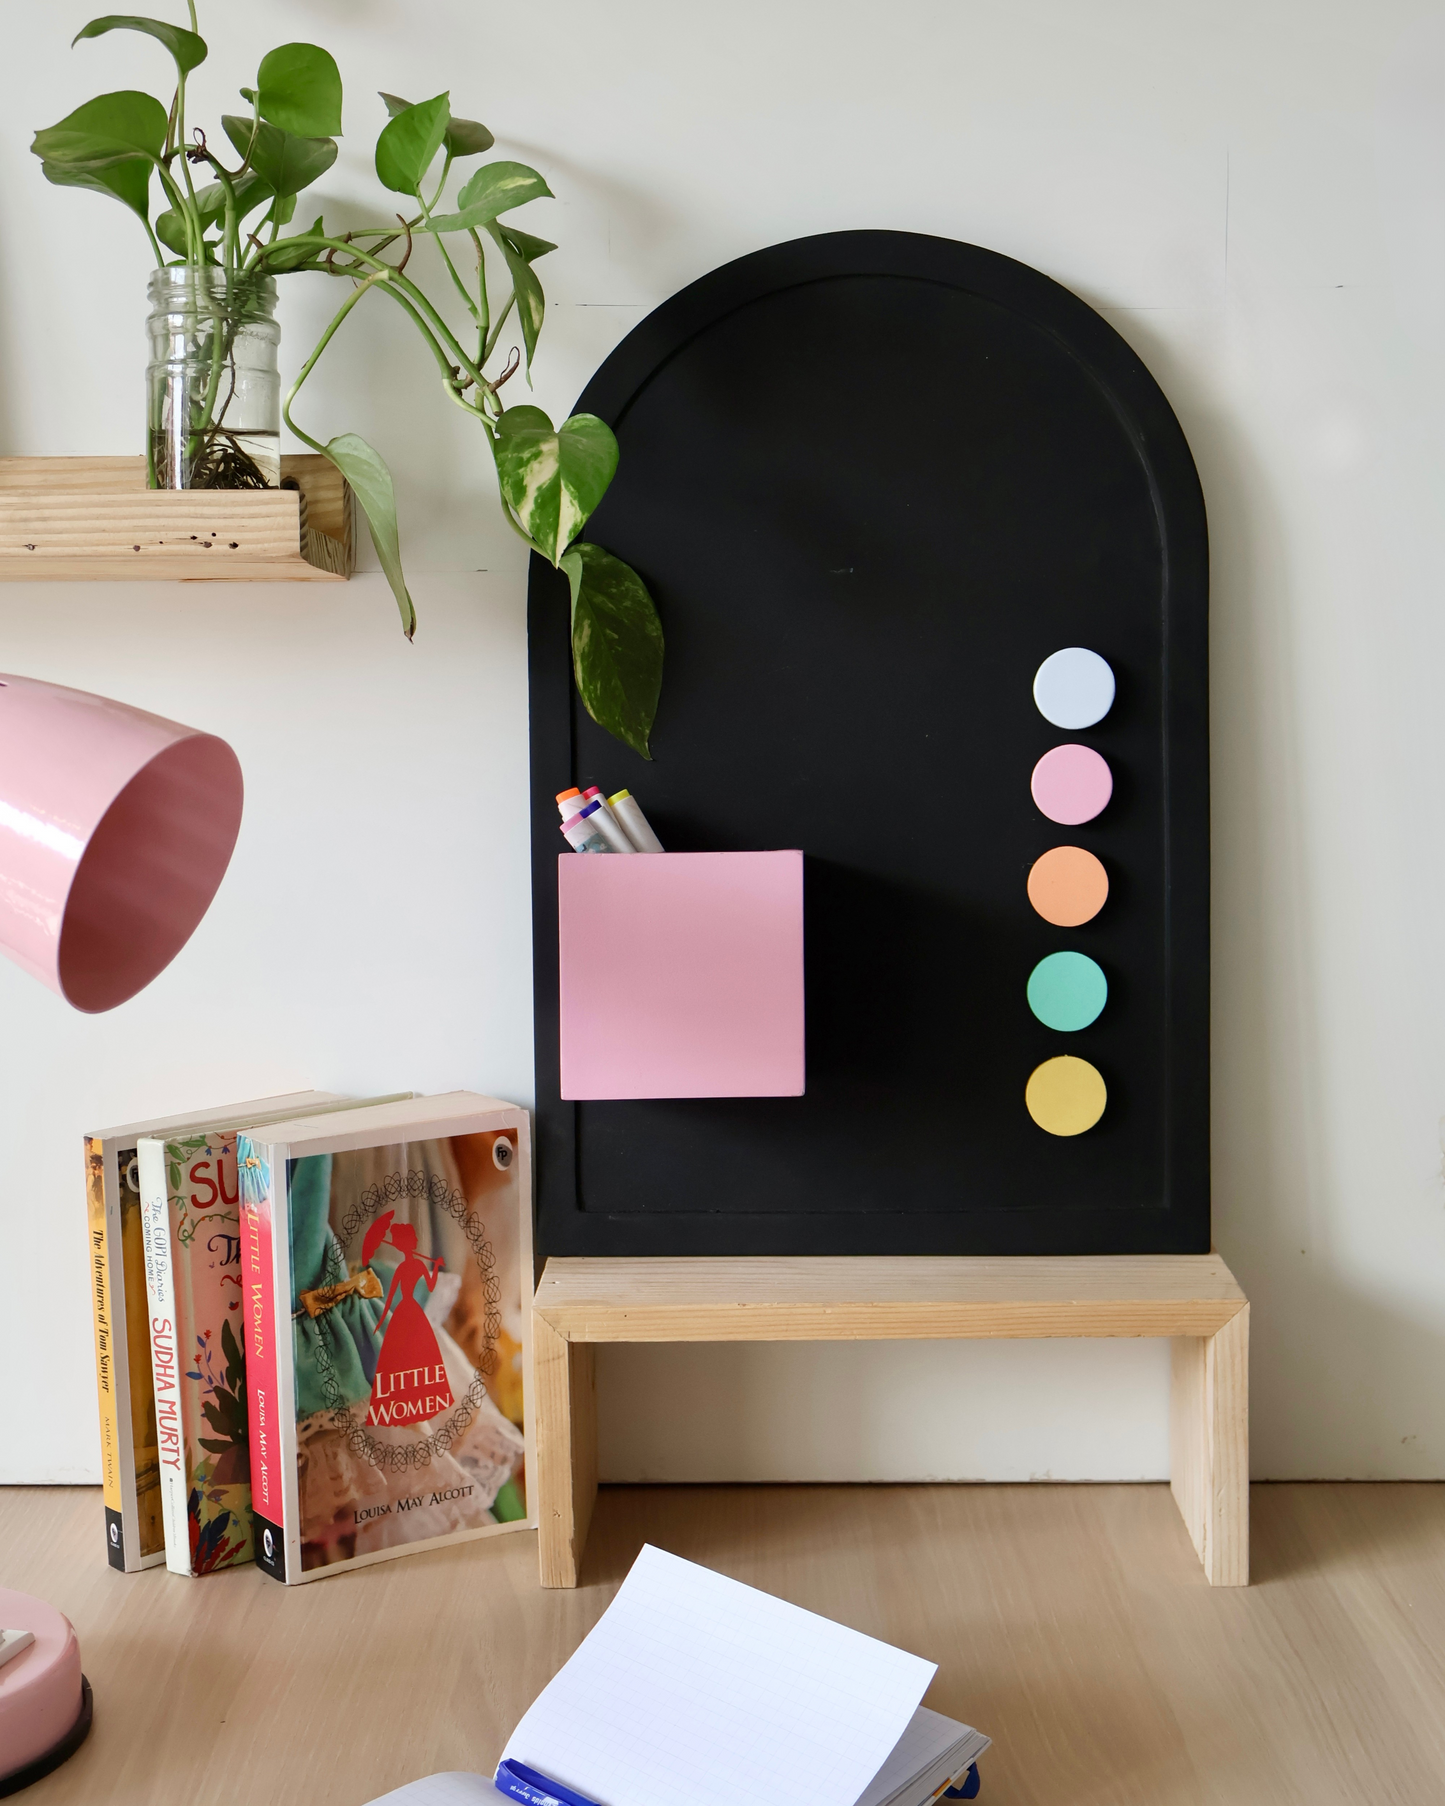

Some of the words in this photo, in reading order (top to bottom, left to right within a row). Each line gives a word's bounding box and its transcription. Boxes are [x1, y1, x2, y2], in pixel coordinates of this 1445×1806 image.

[151, 1196, 163, 1223] The
[93, 1229, 104, 1250] The
[143, 1215, 153, 1256] COMING
[153, 1227, 168, 1258] GOPI
[247, 1209, 261, 1275] LITTLE
[94, 1253, 106, 1312] Adventures
[147, 1256, 155, 1282] HOME
[155, 1259, 168, 1303] Diaries
[98, 1313, 109, 1326] of
[251, 1283, 264, 1359] WOMEN
[98, 1328, 109, 1351] Tom
[152, 1317, 176, 1392] SUDHA
[99, 1353, 110, 1393] Sawyer
[375, 1364, 446, 1399] LITTLE
[257, 1388, 266, 1427] LOUISA
[369, 1393, 450, 1426] WOMEN
[104, 1416, 112, 1447] MARK
[158, 1397, 181, 1471] MURTY
[259, 1429, 268, 1458] MAY
[106, 1452, 114, 1488] TWAIN
[260, 1460, 269, 1505] ALCOTT
[353, 1505, 392, 1524] LOUISA
[396, 1495, 425, 1513] MAY
[429, 1485, 474, 1506] ALCOTT
